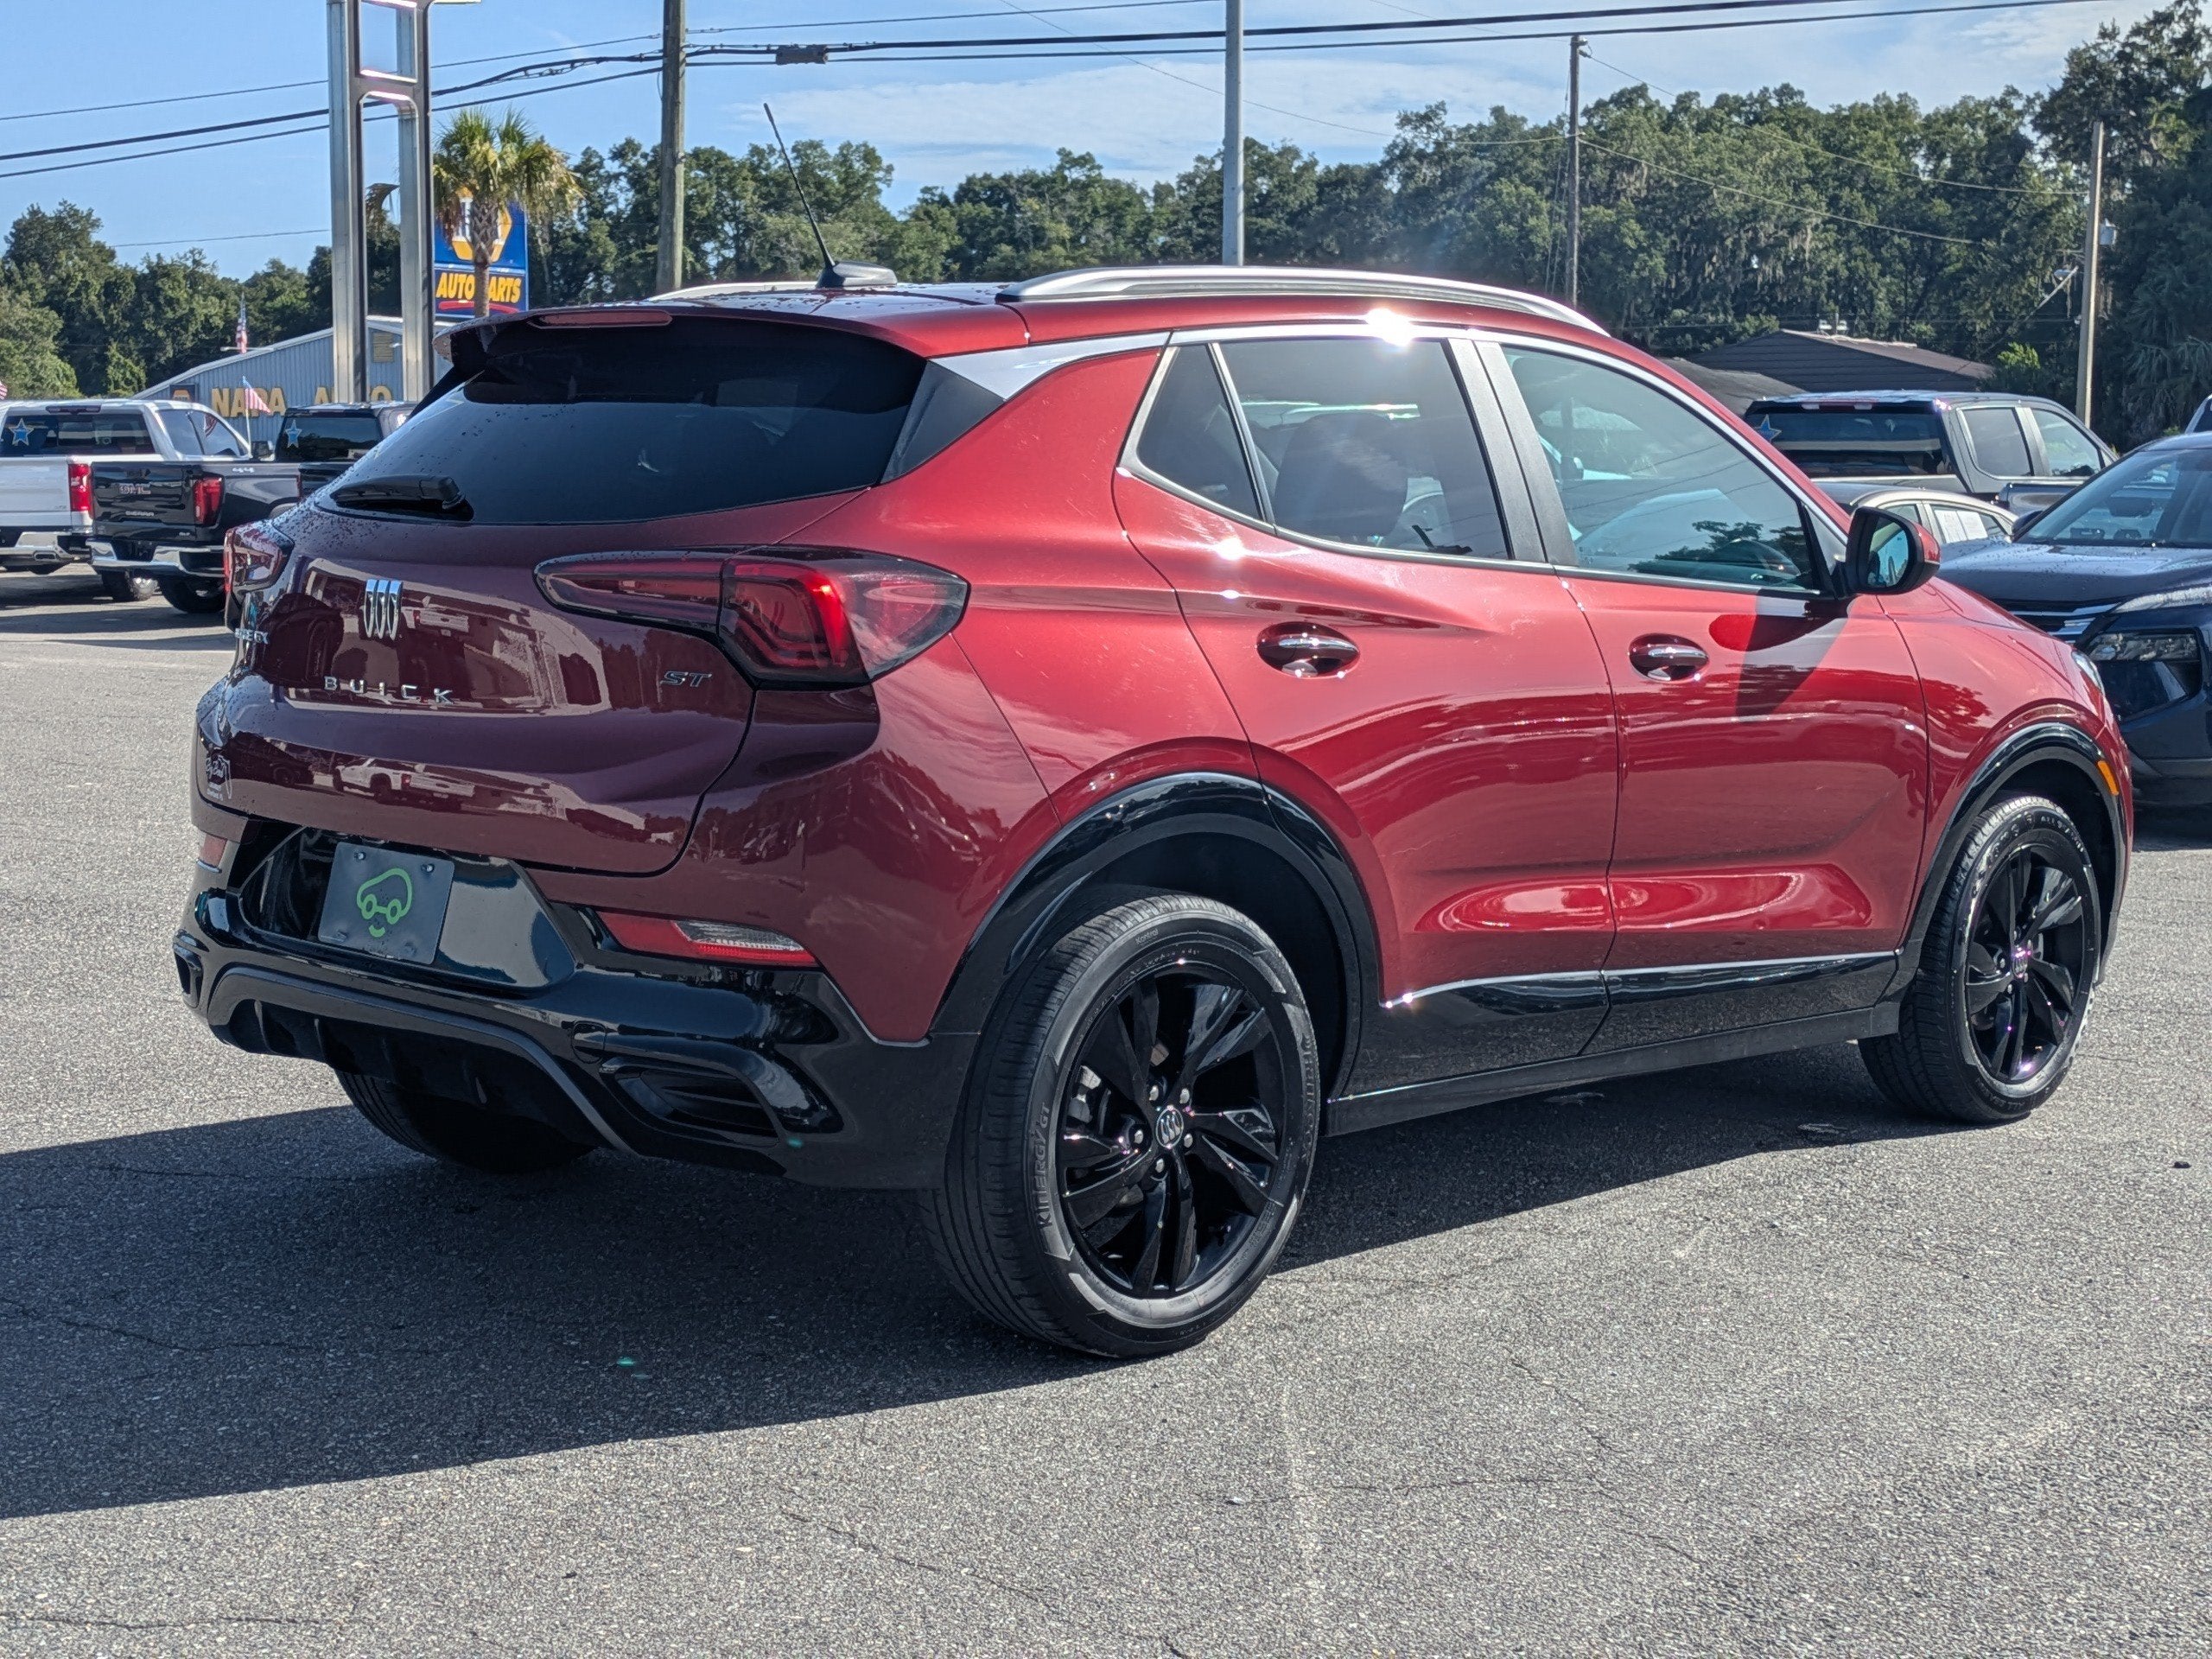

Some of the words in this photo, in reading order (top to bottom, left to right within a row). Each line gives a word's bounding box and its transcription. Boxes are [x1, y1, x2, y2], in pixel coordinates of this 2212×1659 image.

[436, 272, 474, 299] AUTO
[486, 276, 522, 303] ARTS
[324, 676, 454, 706] BUICK
[659, 671, 712, 687] ST
